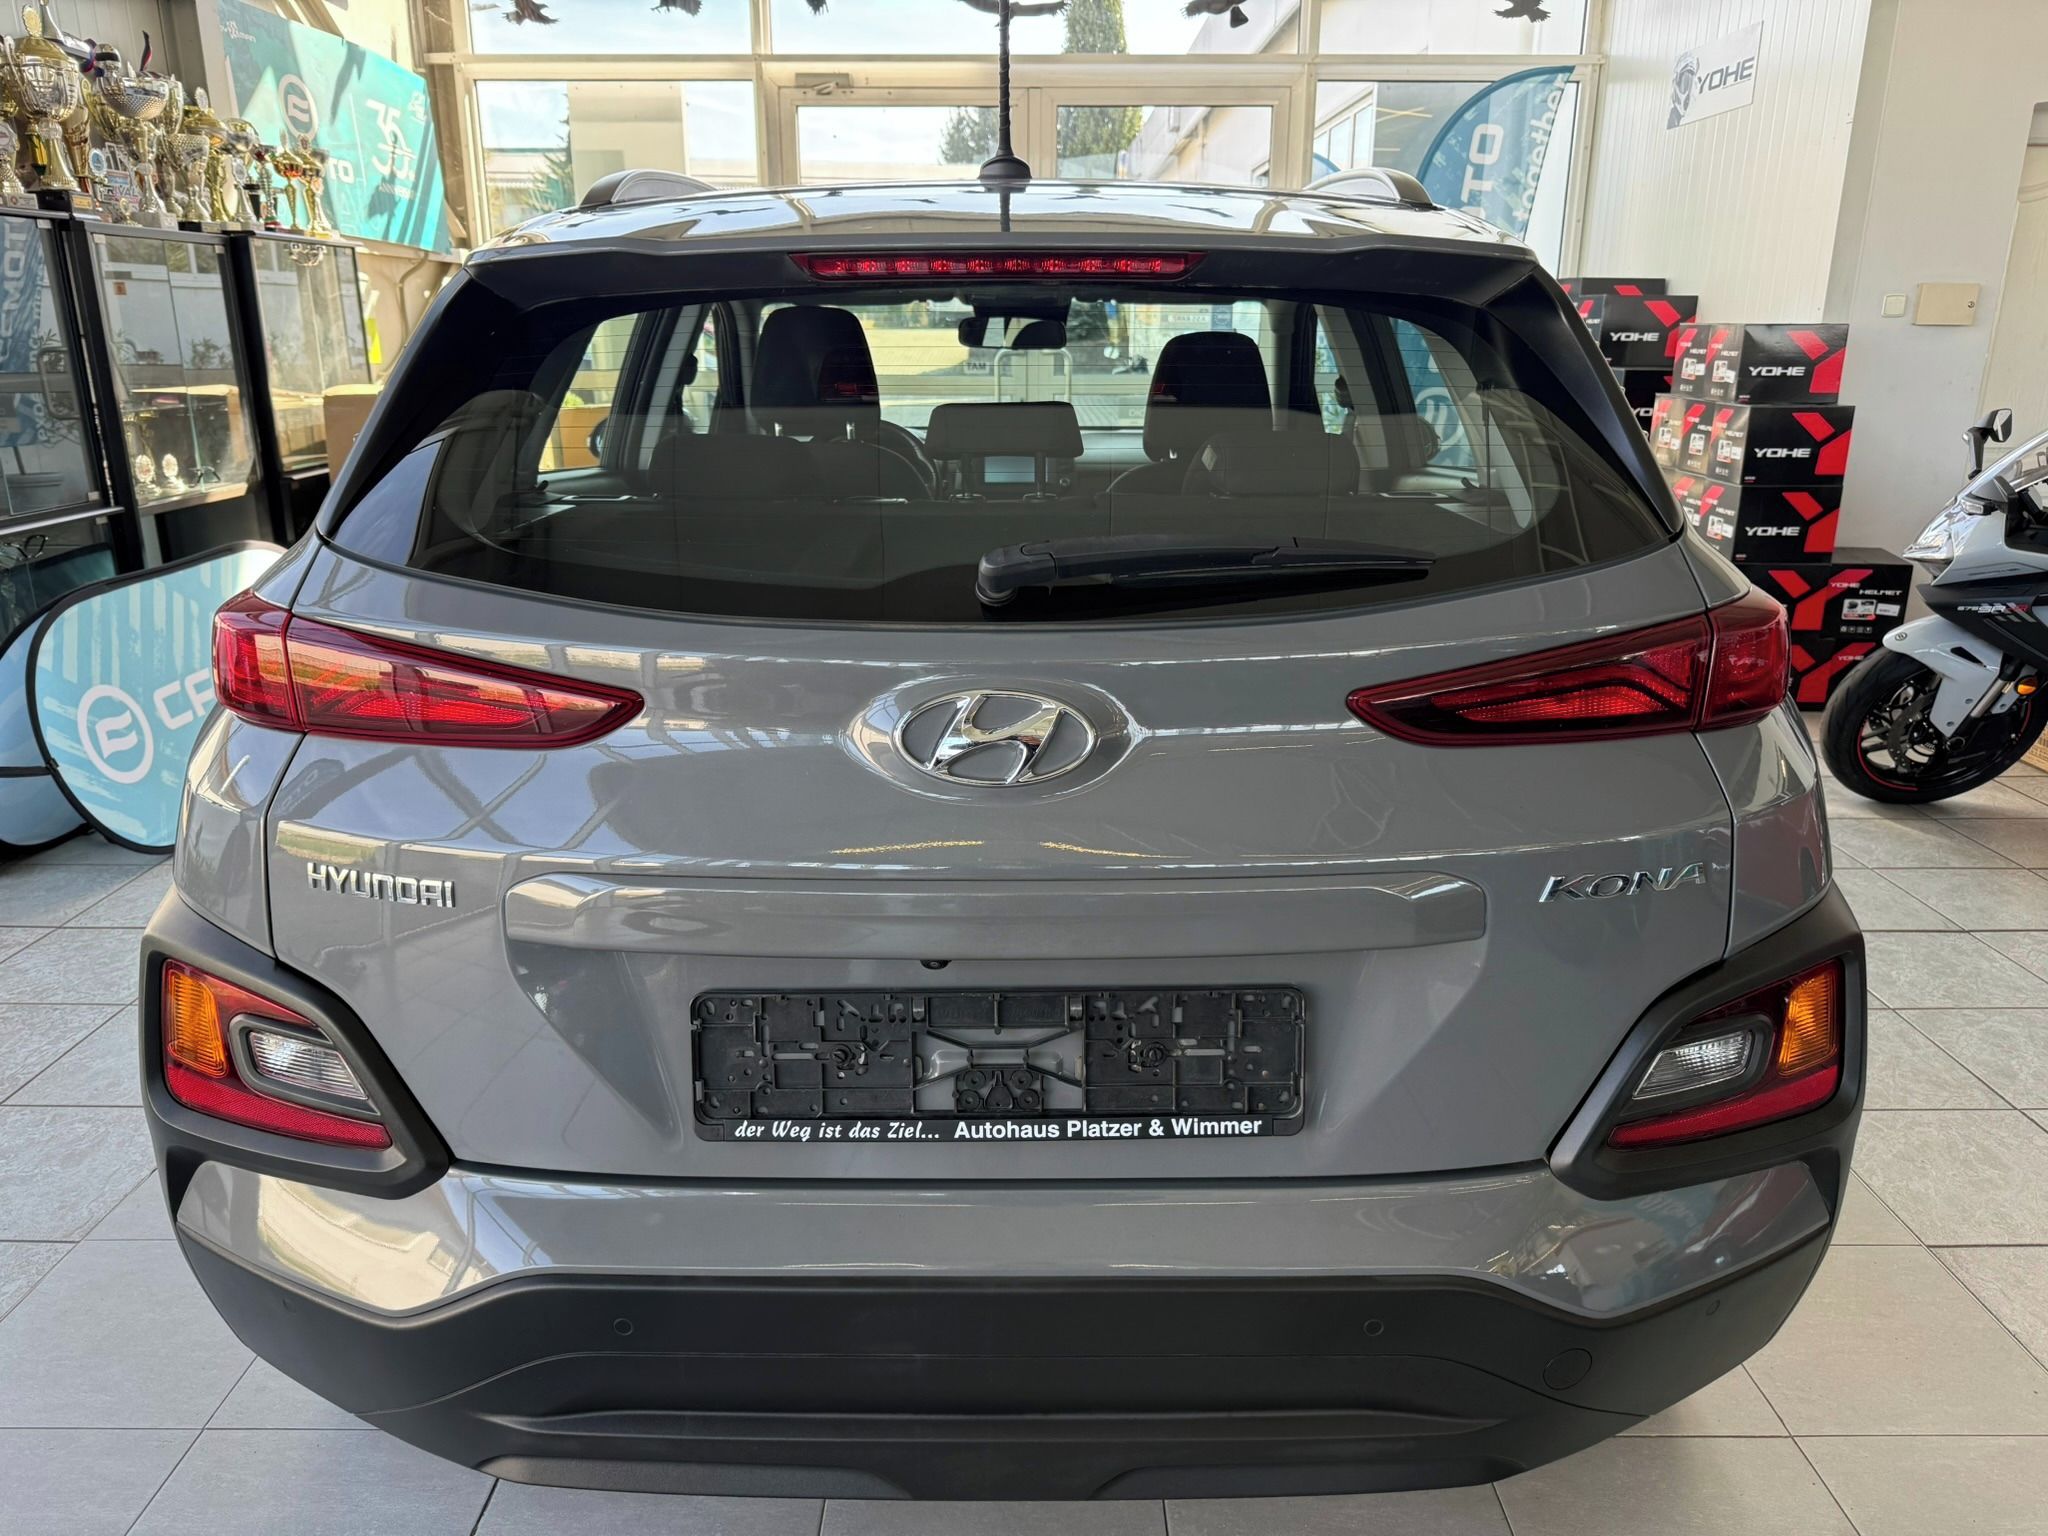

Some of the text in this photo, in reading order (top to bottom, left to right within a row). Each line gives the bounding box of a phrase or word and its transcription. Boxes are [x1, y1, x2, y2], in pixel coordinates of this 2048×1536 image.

[1698, 56, 1754, 94] YOHE
[1461, 123, 1504, 219] TO
[1610, 332, 1660, 341] YOHE
[1749, 366, 1806, 376] YOHE
[1632, 407, 1653, 417] YO
[1754, 448, 1811, 458] YOHE
[1745, 526, 1800, 536] YOHE
[306, 862, 455, 908] HYUNDAI
[1539, 862, 1705, 903] KONA
[735, 1117, 1263, 1142] der Weg ist das Ziel... Autohaus Platzer & Wimmer
